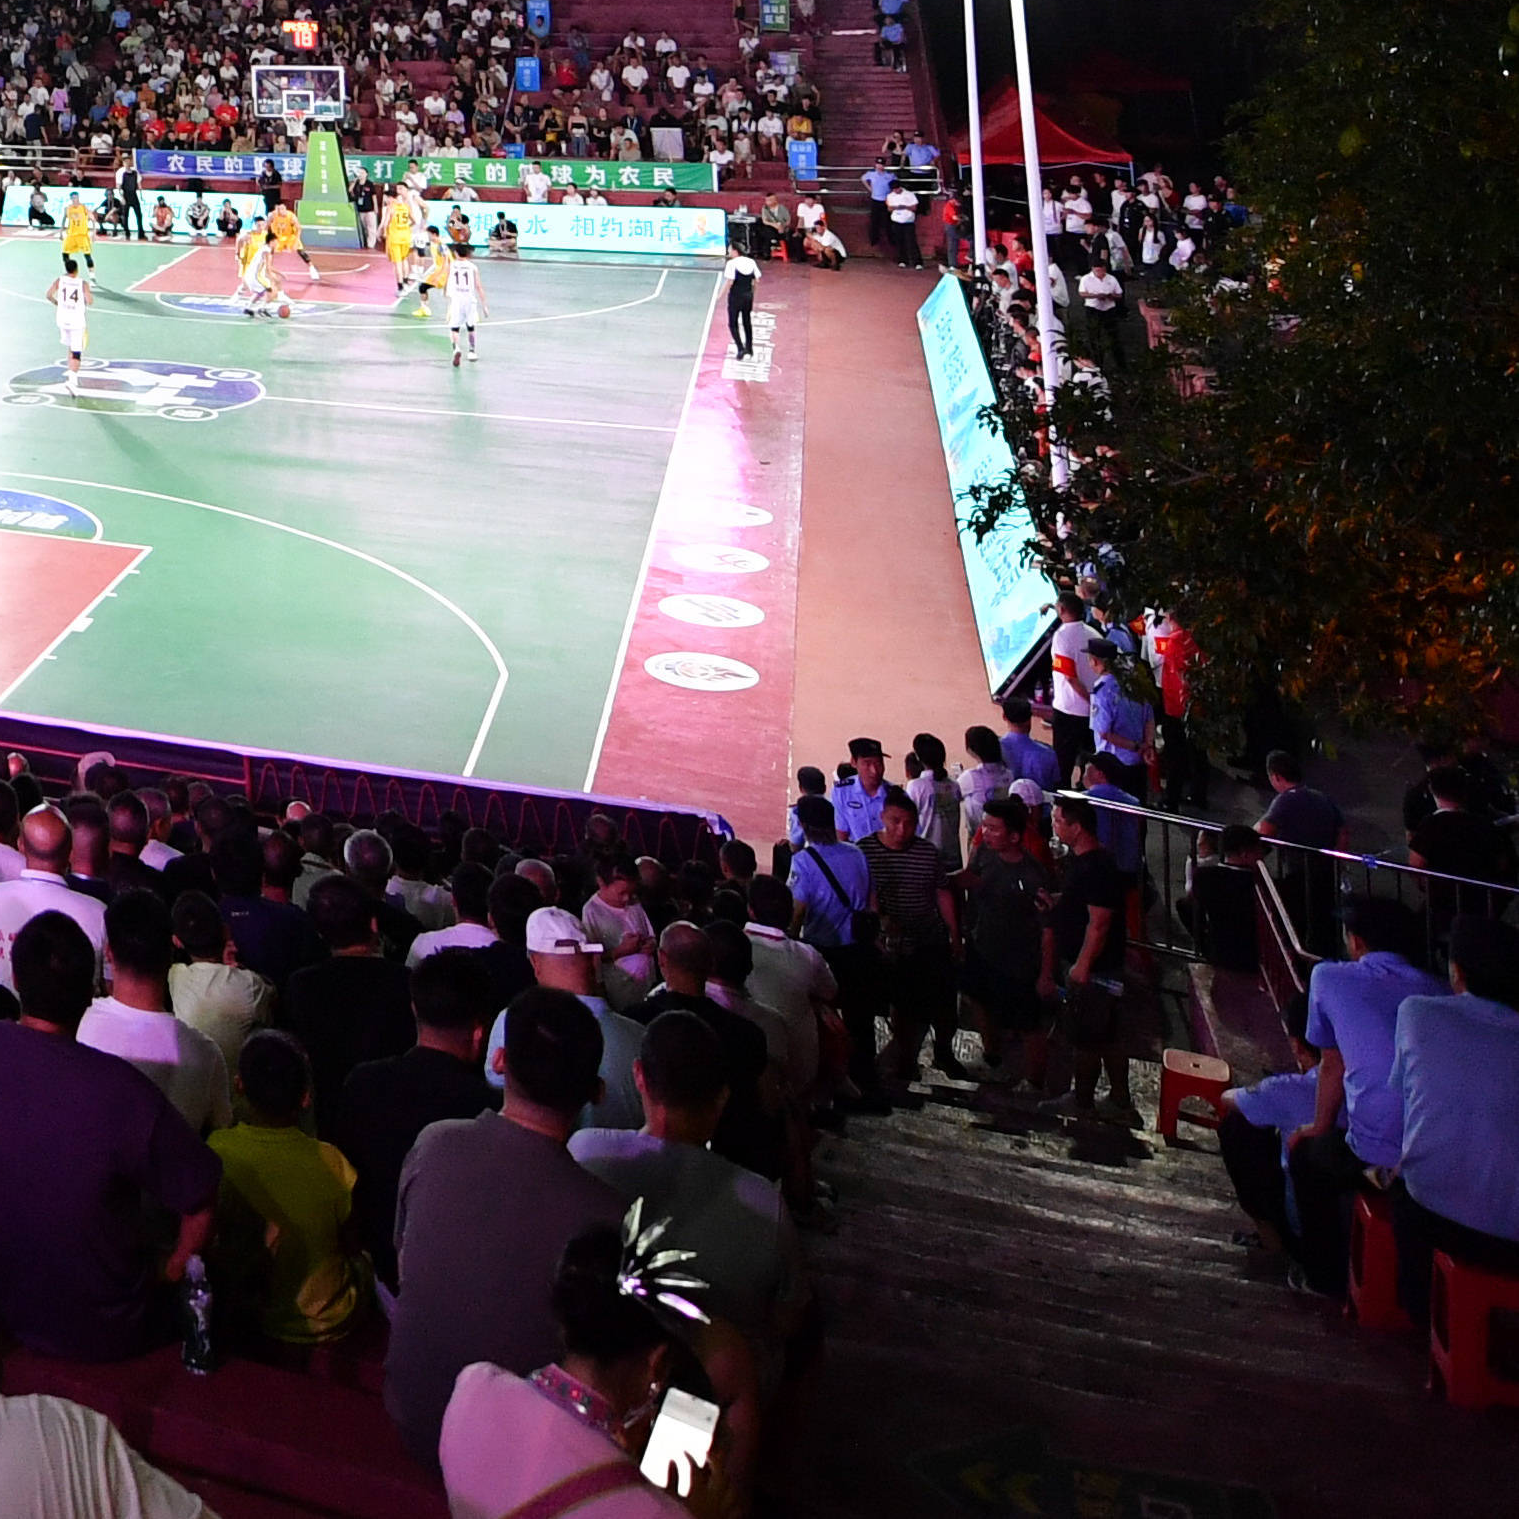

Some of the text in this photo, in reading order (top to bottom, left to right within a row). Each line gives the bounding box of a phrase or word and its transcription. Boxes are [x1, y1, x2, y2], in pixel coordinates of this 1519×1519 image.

[294, 31, 314, 48] 18
[167, 154, 394, 180] 农民的篮球民打
[394, 211, 409, 224] 15
[570, 215, 683, 243] 相约湖南
[453, 272, 470, 285] 11
[61, 287, 79, 303] 14
